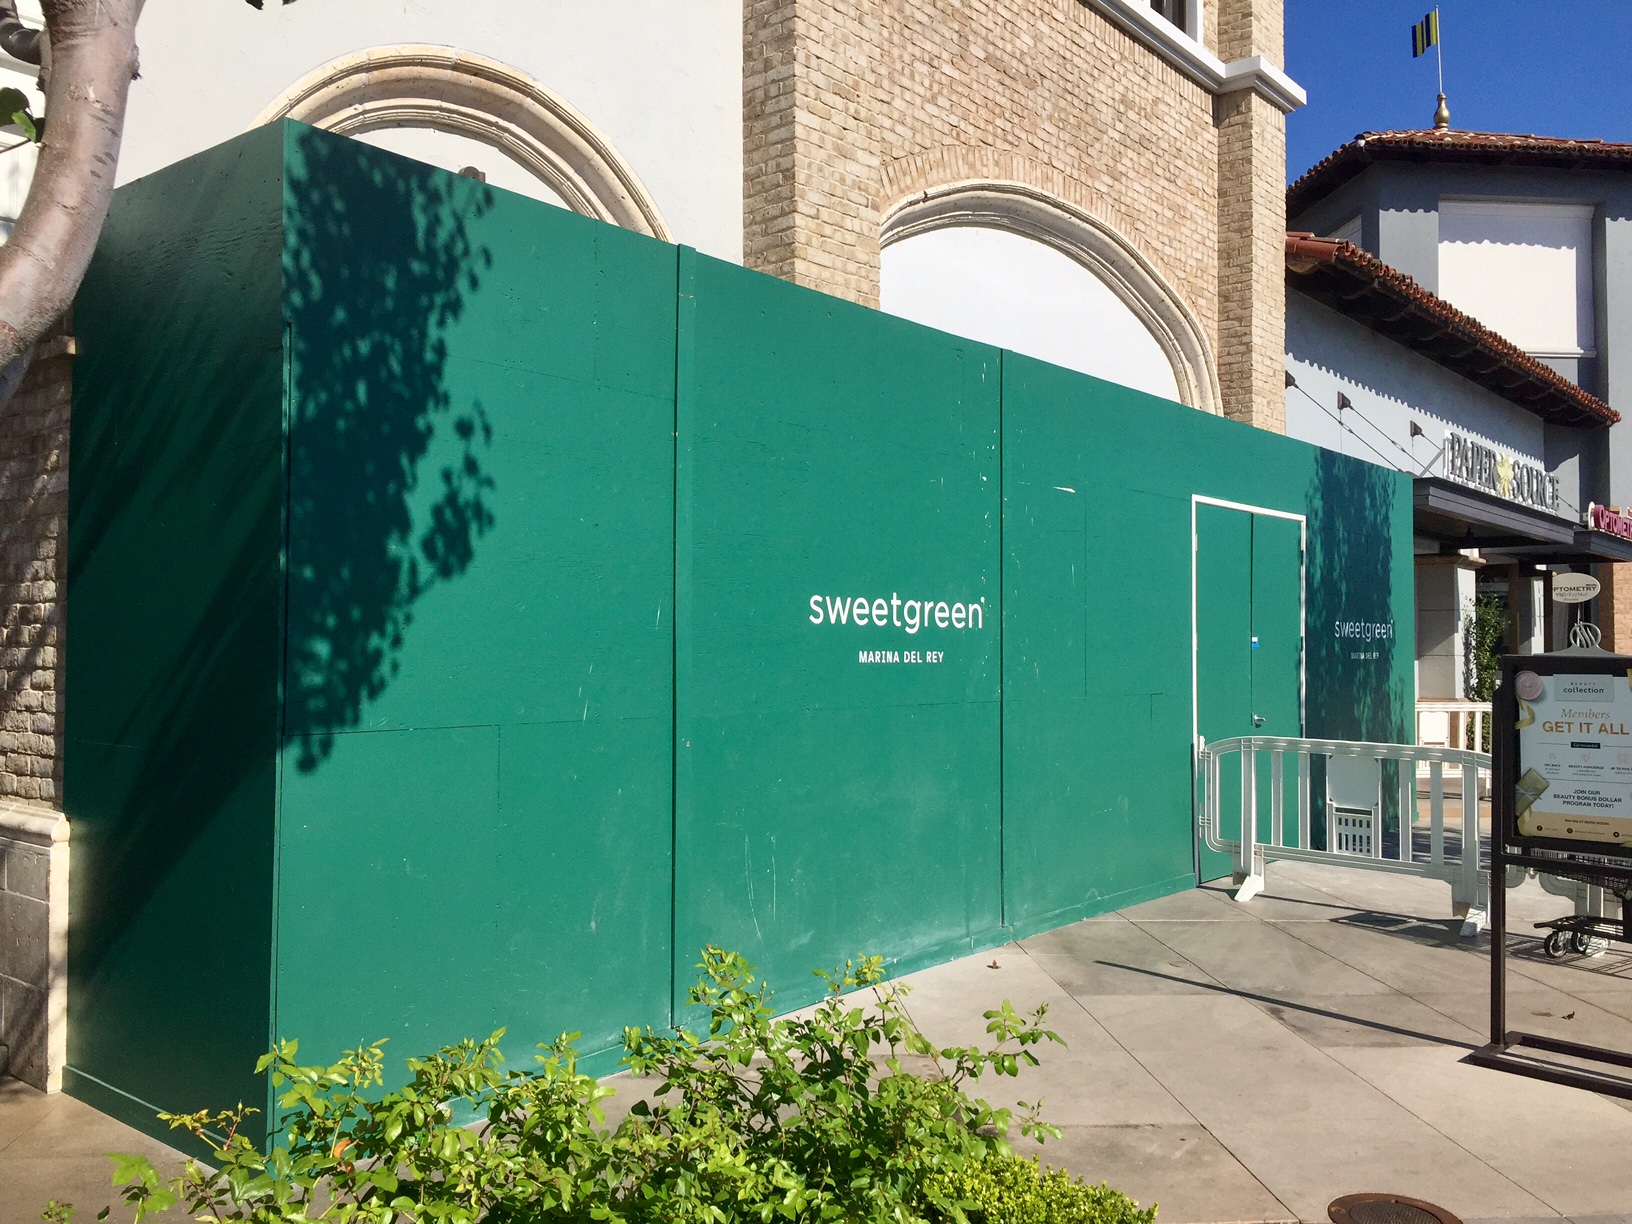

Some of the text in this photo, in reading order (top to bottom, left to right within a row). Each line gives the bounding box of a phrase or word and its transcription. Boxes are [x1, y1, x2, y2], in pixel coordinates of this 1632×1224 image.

[1450, 432, 1559, 511] PAPER SOURCE
[808, 592, 983, 634] sweetgreen
[1334, 618, 1393, 642] sweetgreen
[858, 650, 944, 663] MARINA DEL REY
[1560, 708, 1611, 719] Members
[1542, 720, 1630, 736] GET IT ALL
